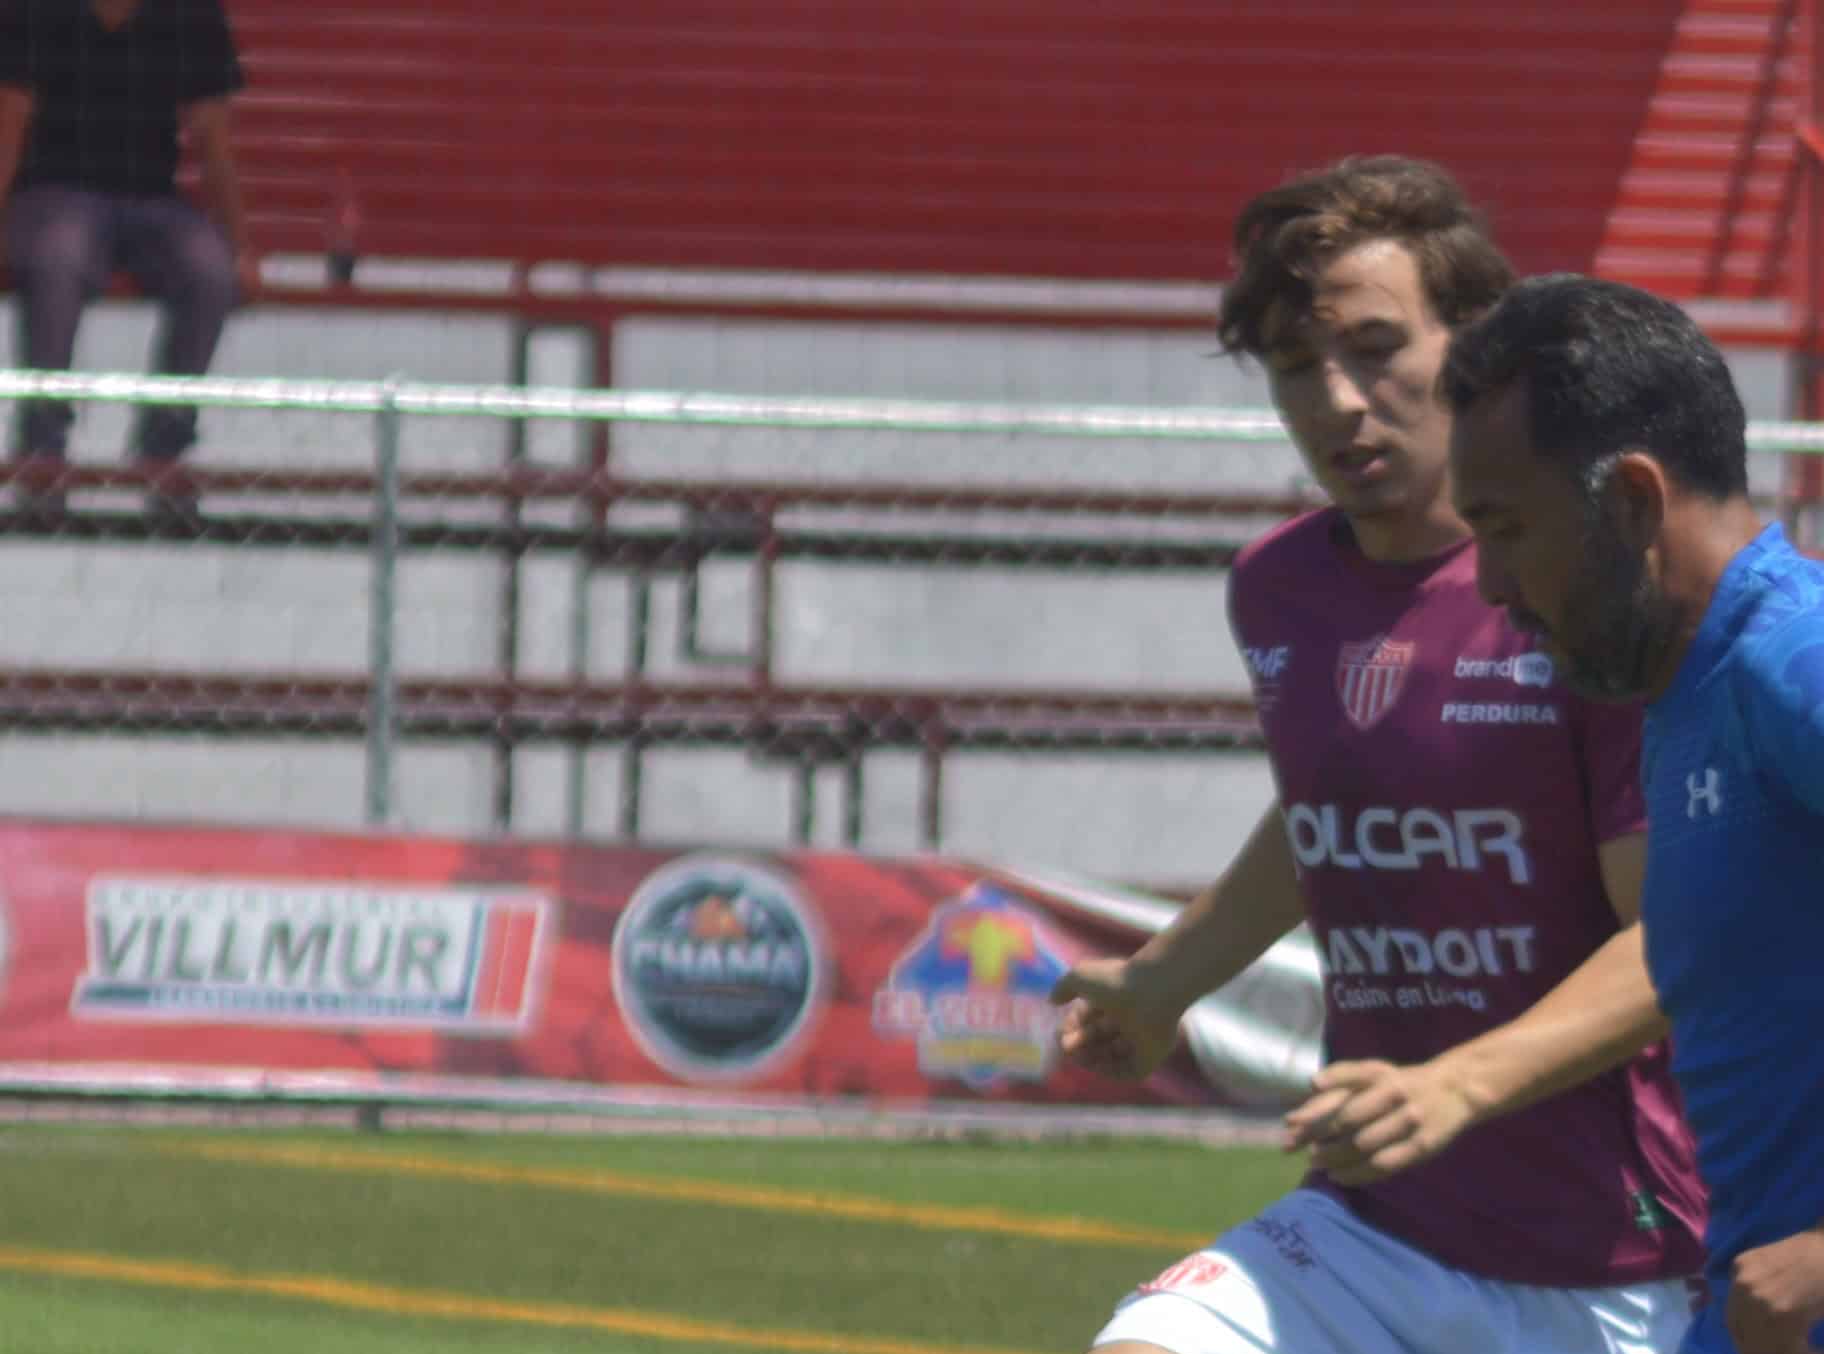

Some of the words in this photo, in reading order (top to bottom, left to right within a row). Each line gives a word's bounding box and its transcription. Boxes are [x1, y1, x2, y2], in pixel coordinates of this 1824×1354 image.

[1441, 703, 1556, 724] PERDURA
[1285, 802, 1531, 884] OLCAR
[96, 914, 453, 993] VILLMUR
[1324, 926, 1537, 978] AYDOIT
